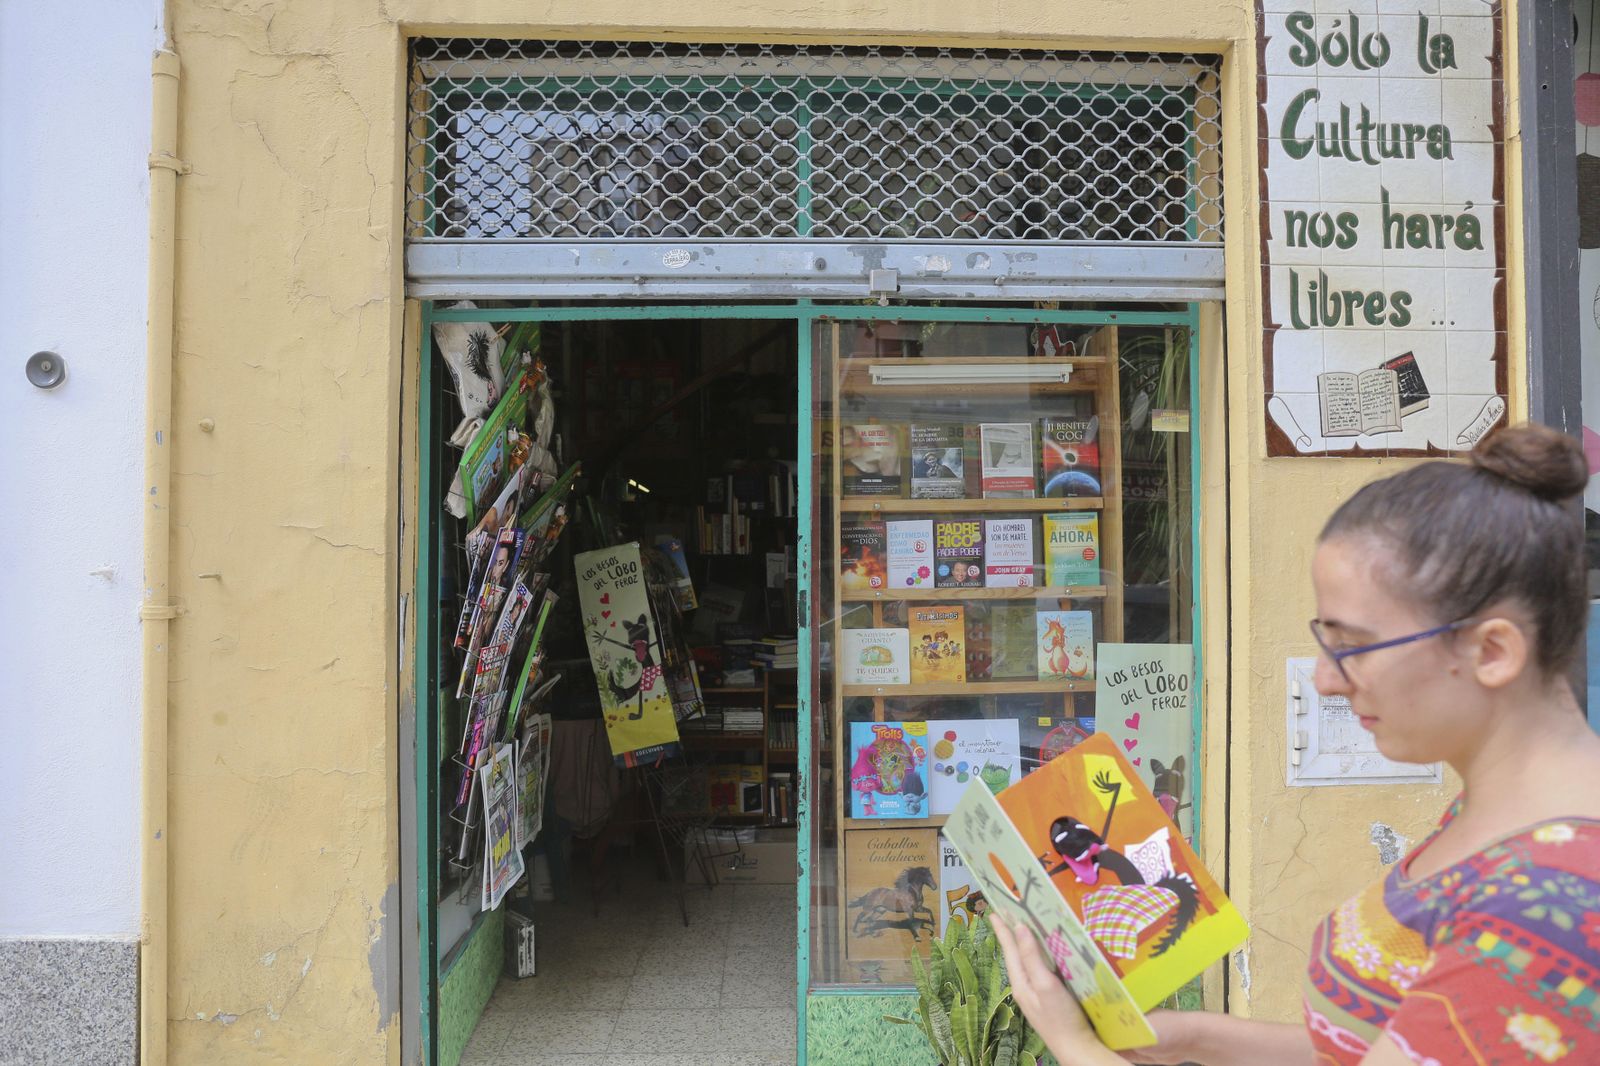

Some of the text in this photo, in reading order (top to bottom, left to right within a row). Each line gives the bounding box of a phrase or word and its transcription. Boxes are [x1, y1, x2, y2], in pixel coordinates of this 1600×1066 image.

[1285, 10, 1458, 74] Sólo la
[1280, 88, 1455, 165] Cultura
[1284, 184, 1485, 251] nos hará
[1289, 267, 1413, 330] libres
[1056, 430, 1083, 441] GOG
[936, 522, 980, 535] PADRE
[860, 537, 879, 545] DIOS
[936, 535, 975, 548] RICO
[1050, 531, 1094, 543] AHORA
[937, 547, 981, 556] PADRE POBRE
[582, 555, 619, 581] LOS BESOS
[593, 560, 637, 591] DEL LOBO
[615, 574, 639, 590] FEROZ
[1105, 659, 1164, 687] LOS BESOS
[1120, 673, 1188, 706] DEL LOBO
[1151, 695, 1187, 711] FEROZ
[875, 728, 903, 740] Trolls
[867, 836, 920, 850] Caballos
